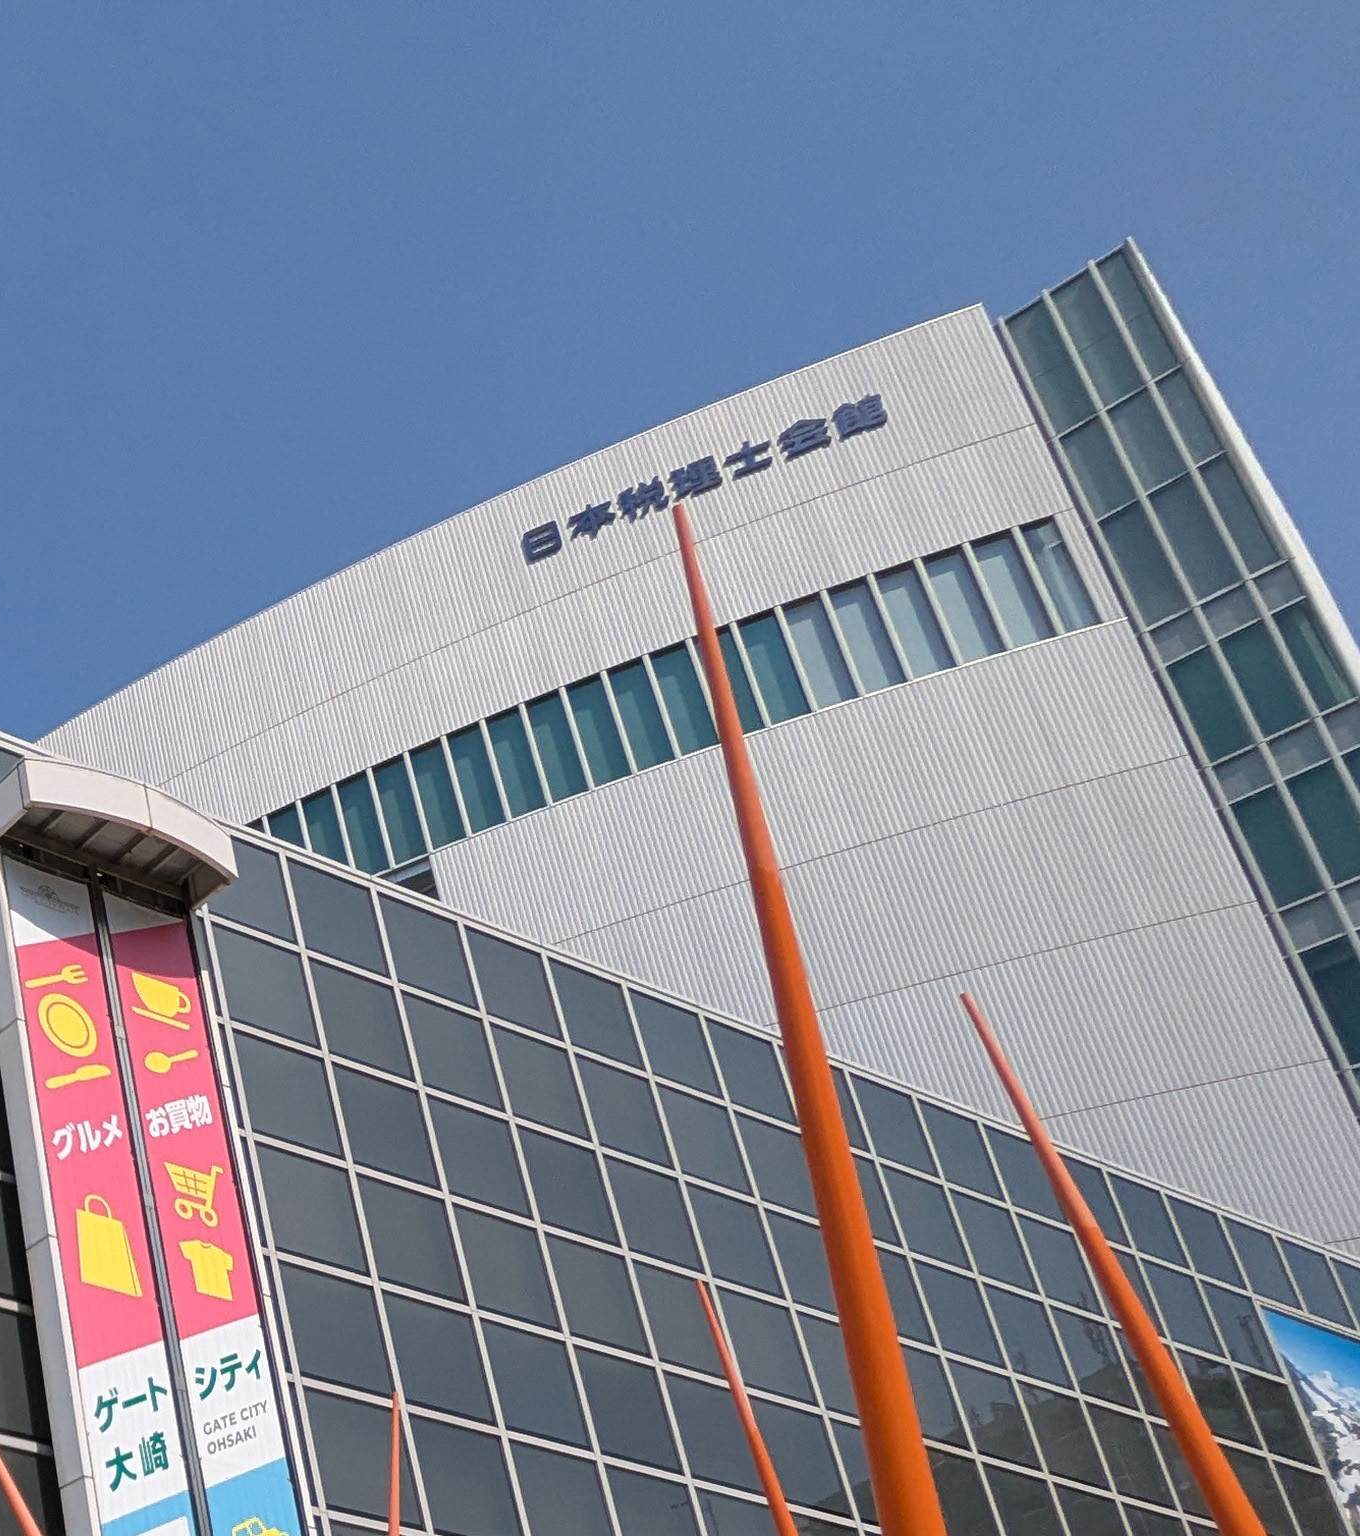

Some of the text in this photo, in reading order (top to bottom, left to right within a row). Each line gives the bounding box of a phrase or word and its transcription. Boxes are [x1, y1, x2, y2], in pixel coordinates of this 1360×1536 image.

[522, 393, 888, 564] 日本税理士会館
[51, 1114, 123, 1160] グルメ
[145, 1094, 213, 1139] お買物
[94, 1349, 262, 1433] ゲート シティ
[203, 1400, 268, 1435] GATE CITY
[207, 1425, 257, 1455] OHSAKI
[105, 1431, 170, 1492] 大崎
